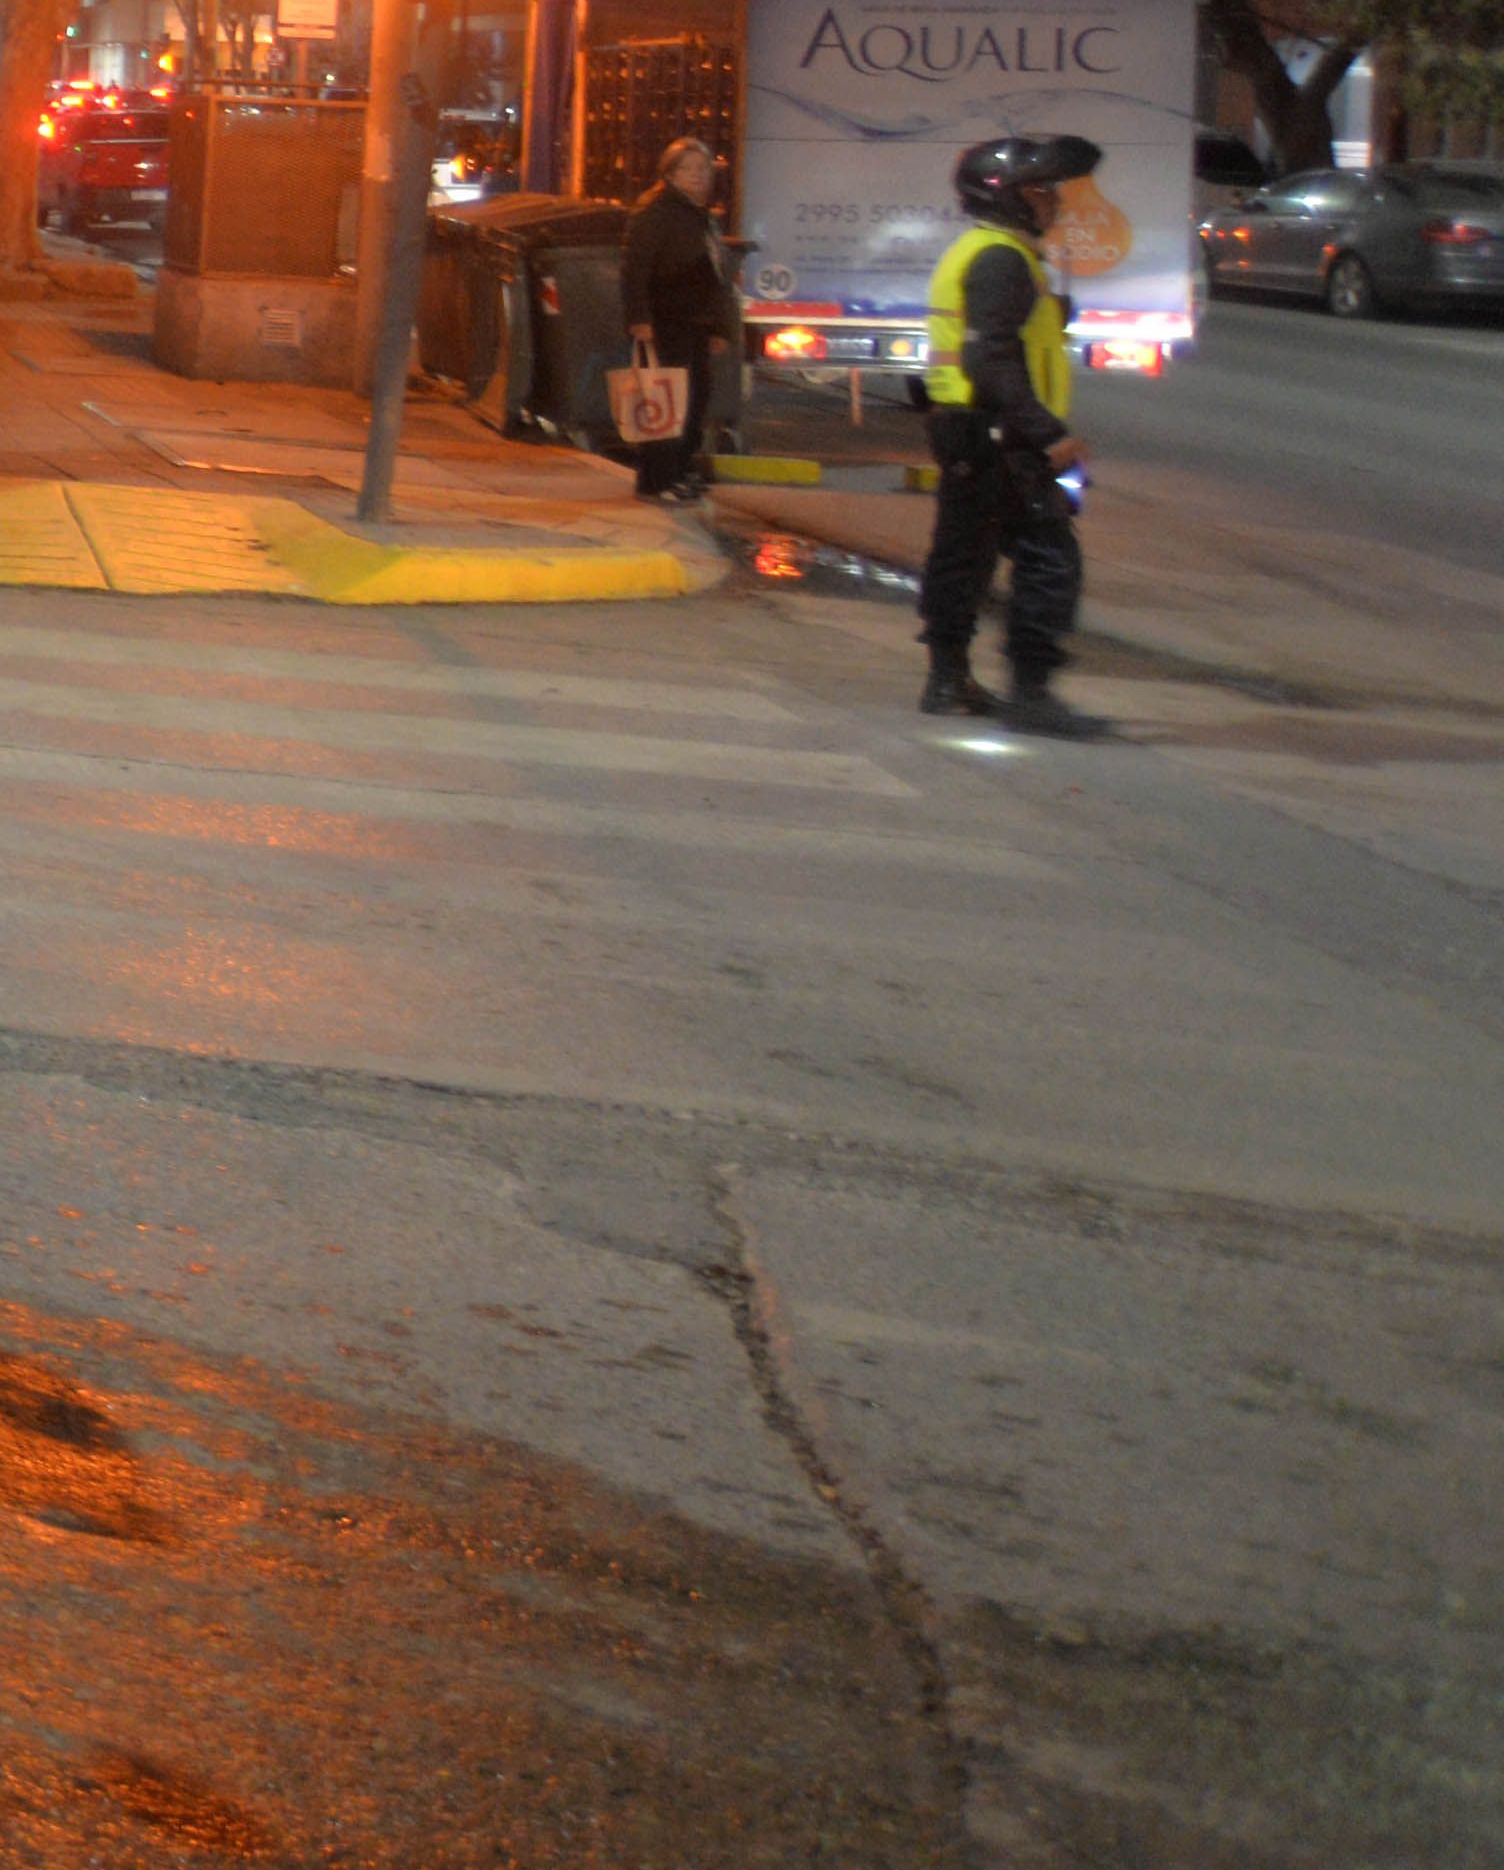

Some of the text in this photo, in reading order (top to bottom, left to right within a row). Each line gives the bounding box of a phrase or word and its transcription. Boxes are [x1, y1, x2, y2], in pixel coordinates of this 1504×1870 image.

[800, 8, 1122, 82] AQUALIC
[793, 202, 859, 223] 2995
[1065, 226, 1096, 243] EN
[758, 269, 790, 293] 90
